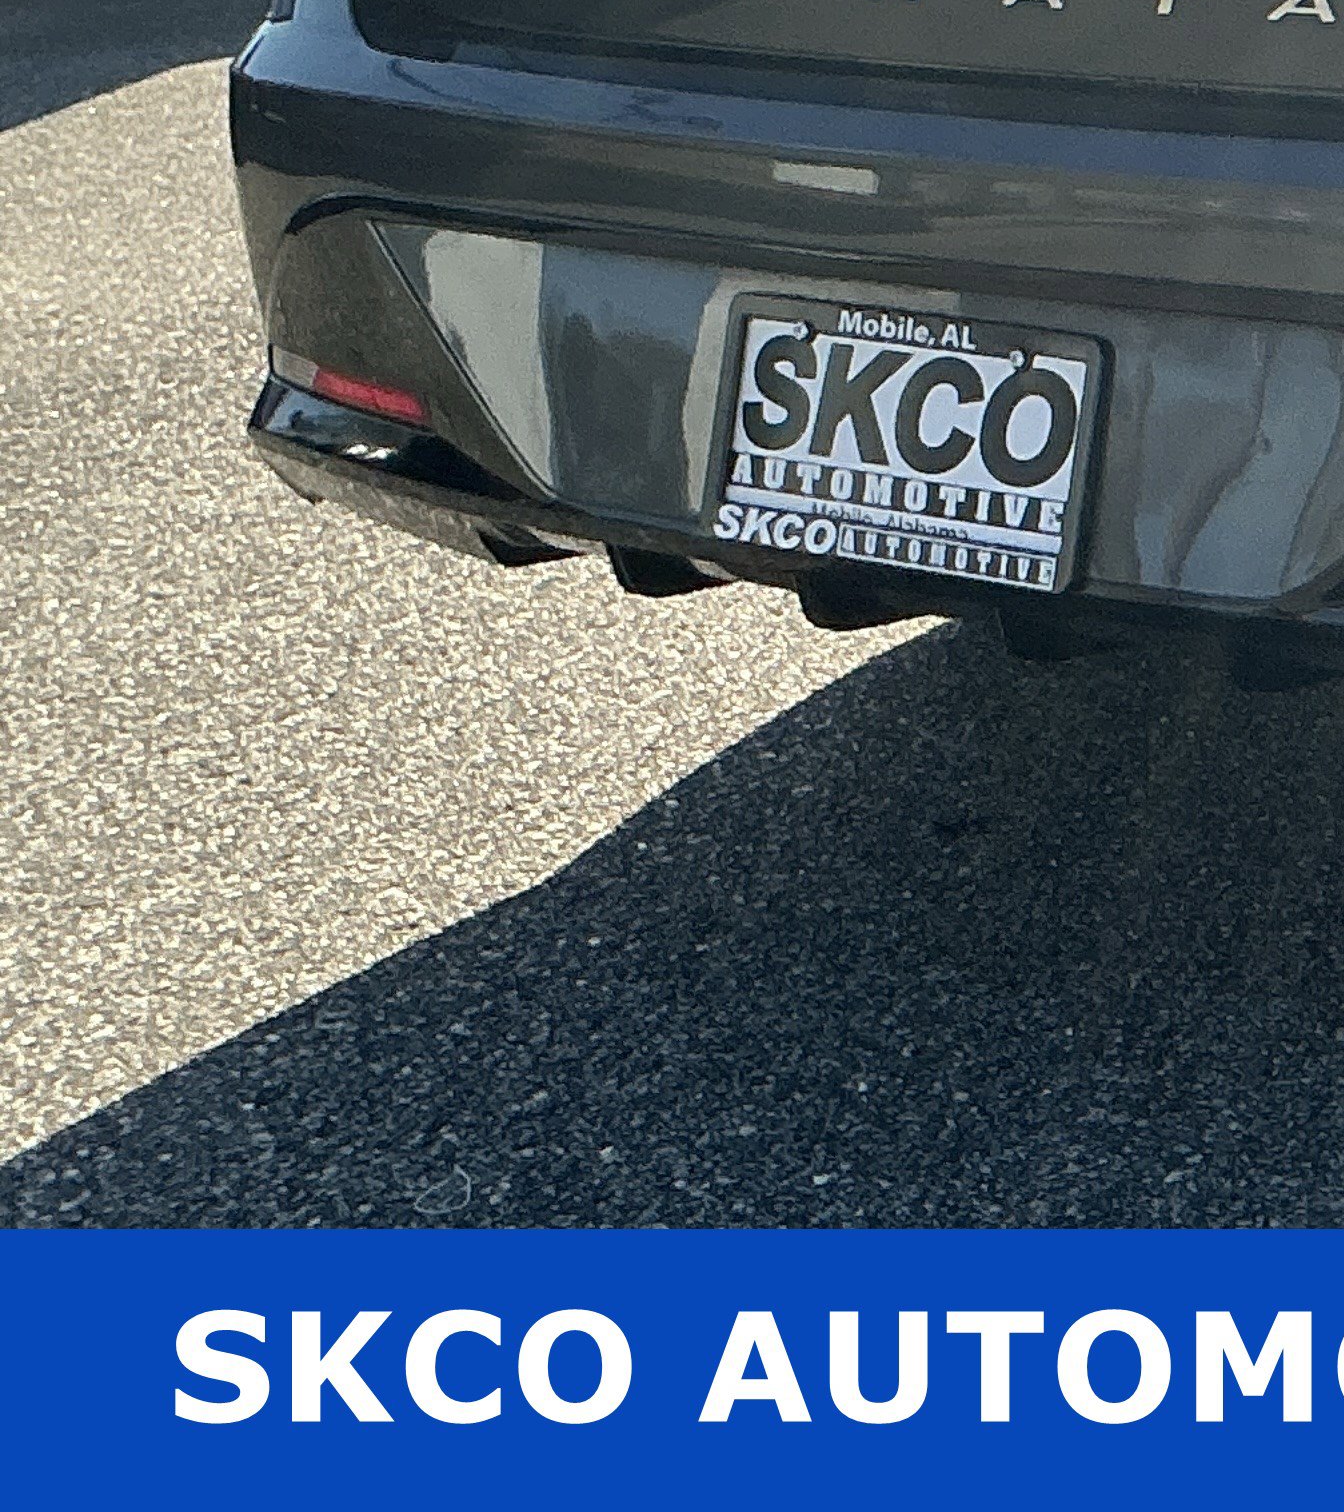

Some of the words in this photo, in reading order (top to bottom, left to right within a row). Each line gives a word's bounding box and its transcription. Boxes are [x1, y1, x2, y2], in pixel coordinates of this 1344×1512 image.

[838, 309, 936, 348] Mobile,
[942, 323, 977, 350] AL
[742, 334, 1078, 487] SKCO
[731, 455, 1064, 532] AUTOMOTIVE
[713, 504, 838, 555] SKCO
[843, 532, 1054, 583] AUTOMOTIVE
